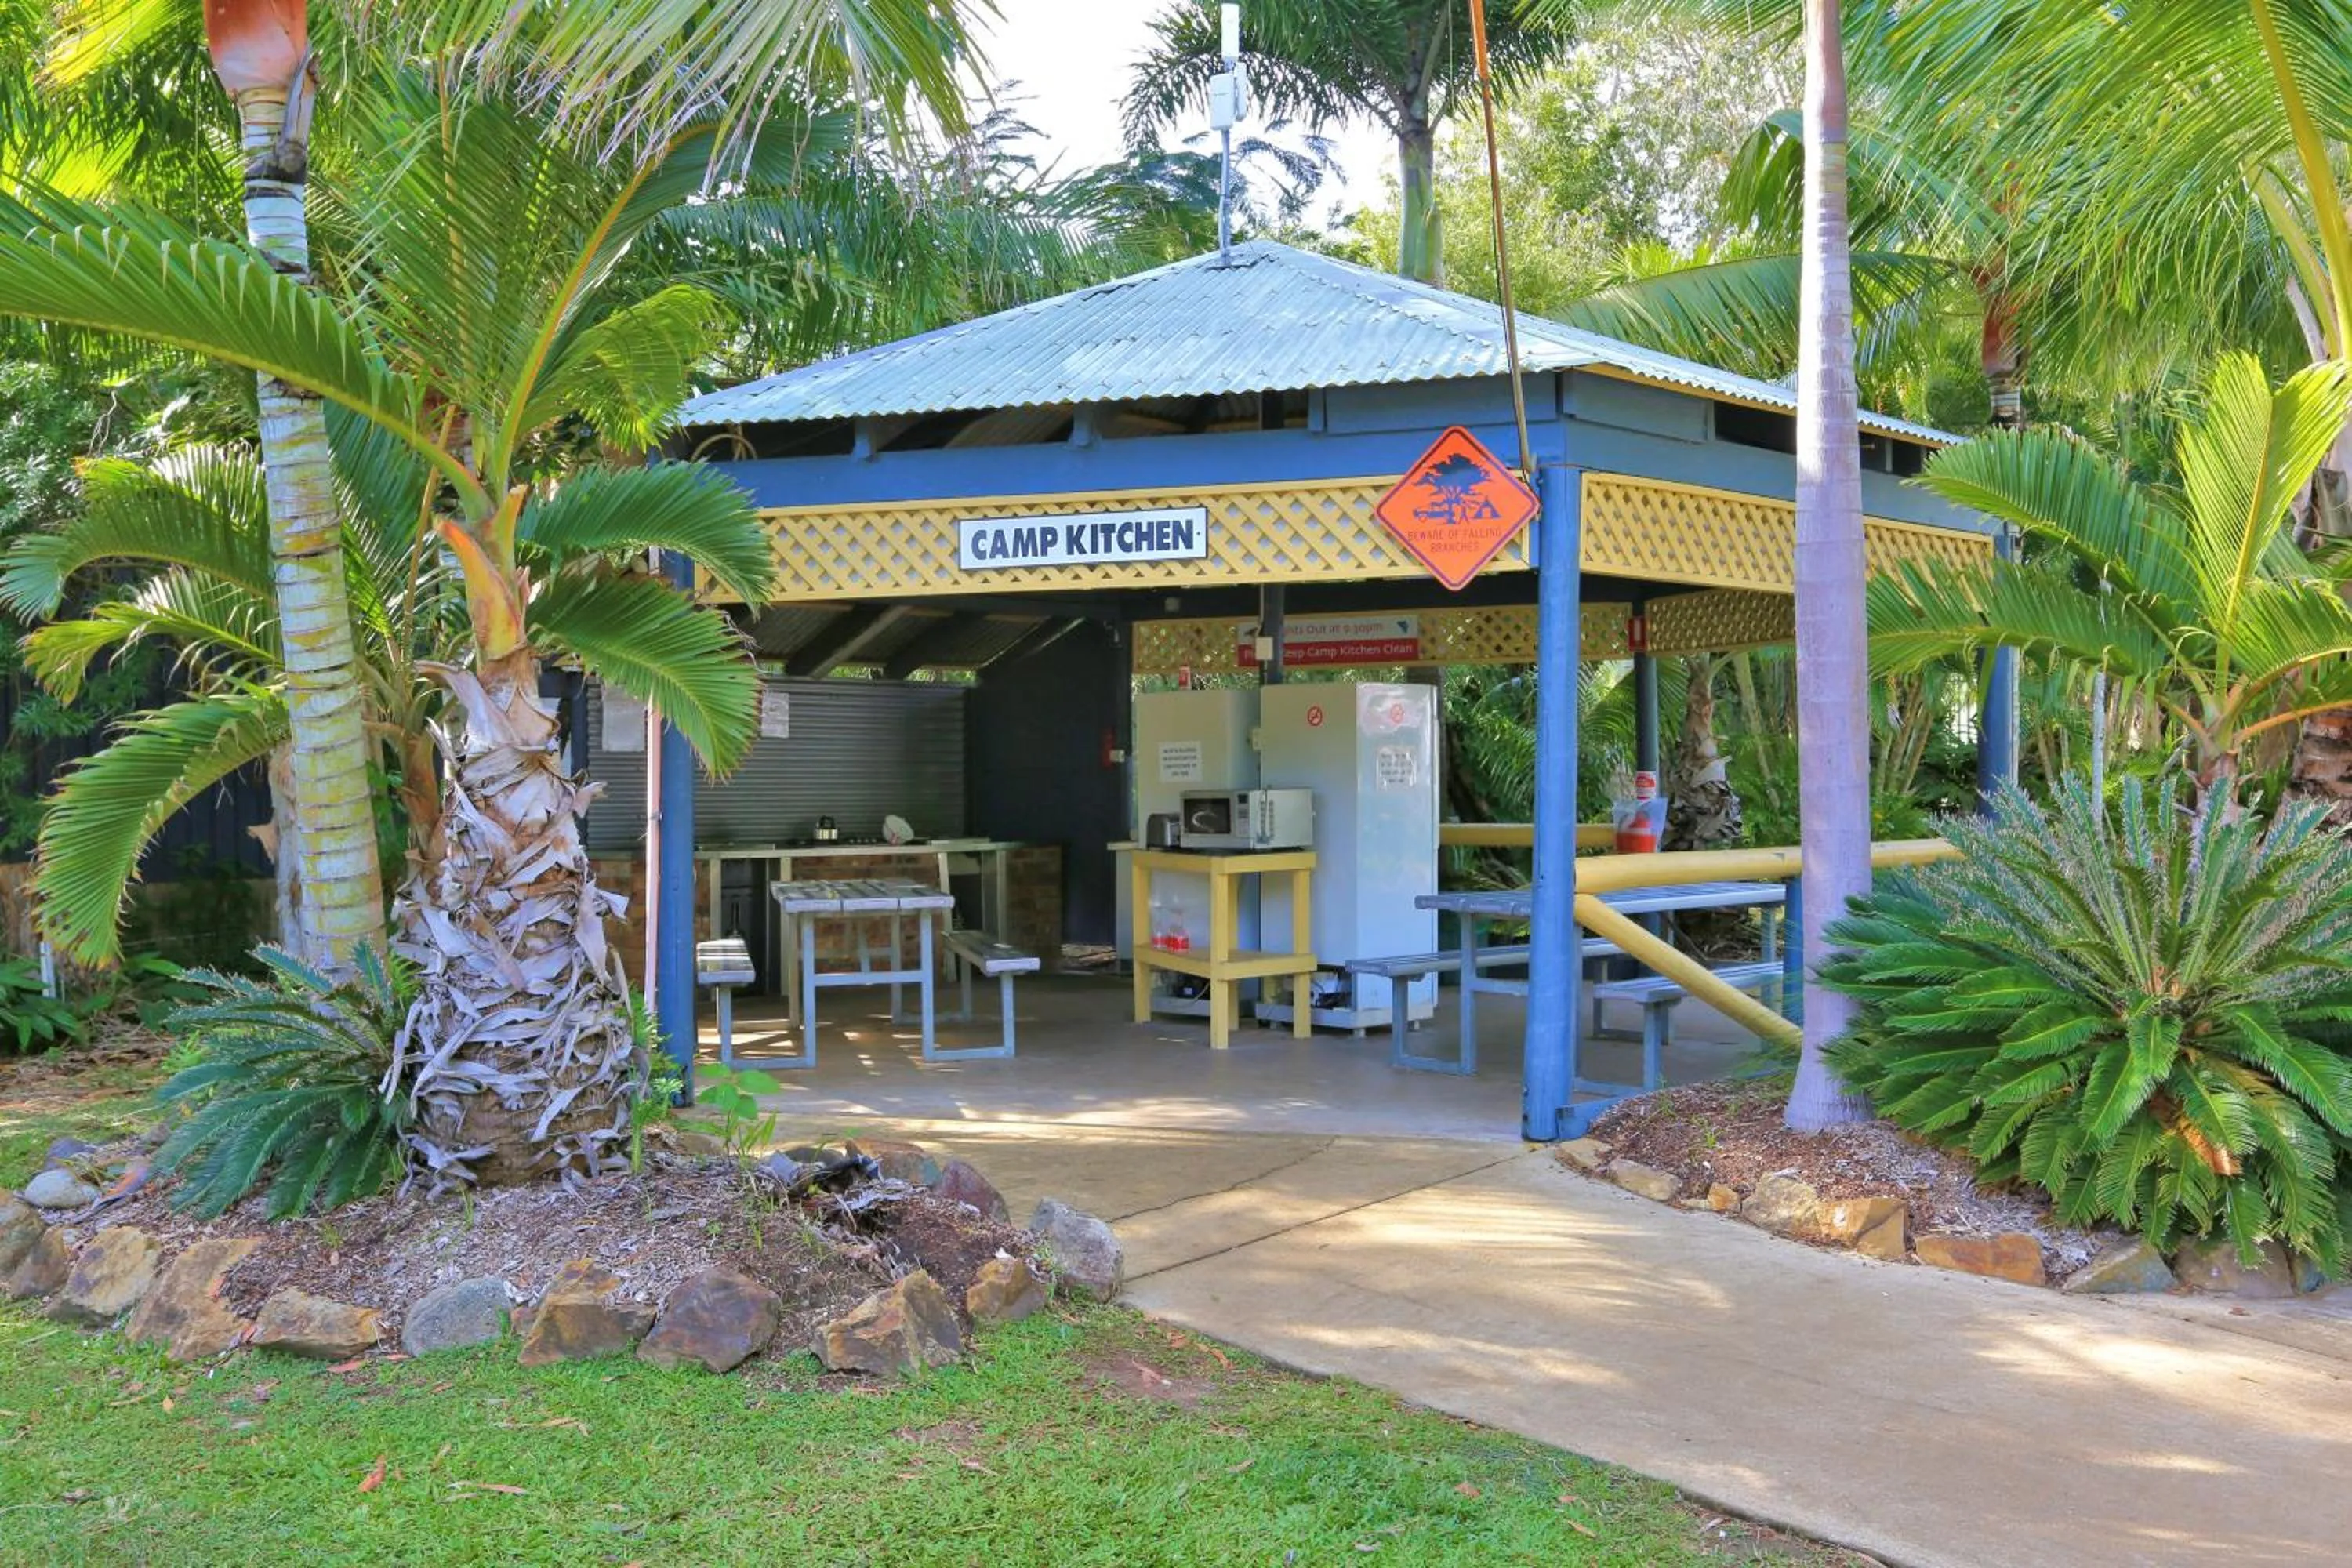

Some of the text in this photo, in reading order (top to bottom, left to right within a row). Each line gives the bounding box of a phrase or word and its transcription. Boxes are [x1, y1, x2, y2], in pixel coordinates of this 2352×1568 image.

[971, 519, 1195, 561] CAMP KITCHEN
[1407, 528, 1502, 541] BEWARE OF FALLING
[1429, 541, 1480, 553] BRANCHES
[1307, 646, 1338, 659] Camp
[1339, 644, 1381, 656] Kitchen
[1382, 643, 1413, 654] Clean
